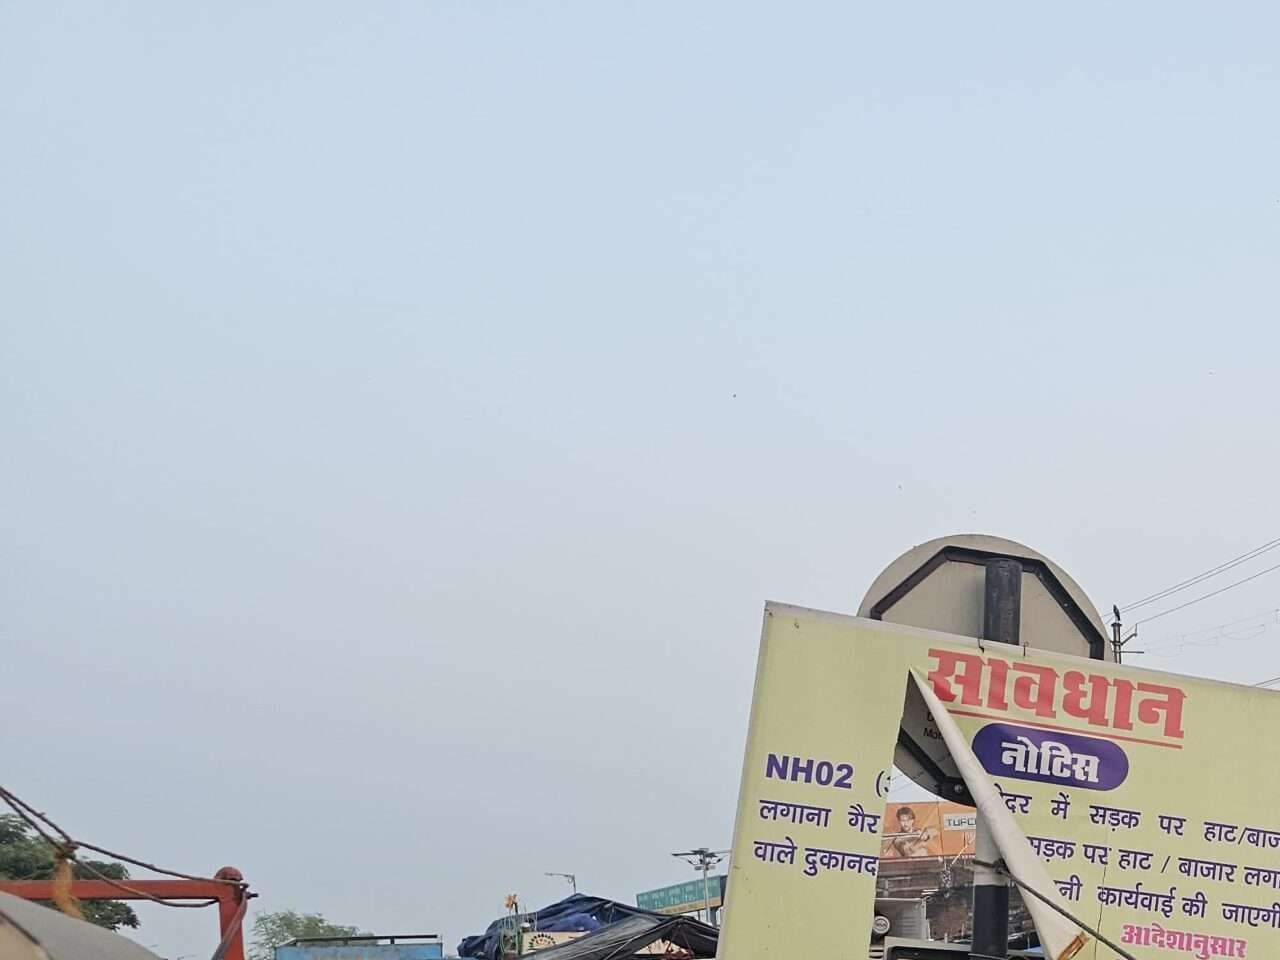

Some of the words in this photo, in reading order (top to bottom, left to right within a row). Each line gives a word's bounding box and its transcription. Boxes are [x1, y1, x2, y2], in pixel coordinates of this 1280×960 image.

[928, 648, 1187, 739] सावधान
[766, 753, 854, 789] NH02
[1051, 792, 1070, 820] में
[1089, 804, 1141, 831] सड़क
[1158, 814, 1186, 836] पर
[1001, 736, 1100, 783] नोटिस
[754, 836, 798, 865] वाले
[1097, 882, 1177, 918] कार्यवाई
[1182, 891, 1208, 918] की
[759, 799, 831, 828] लगाना
[848, 803, 881, 834] गैर
[1083, 843, 1111, 866] पर
[1118, 848, 1153, 870] हाट
[1178, 857, 1237, 882] बाजार
[1121, 923, 1248, 960] आदेशानुसार
